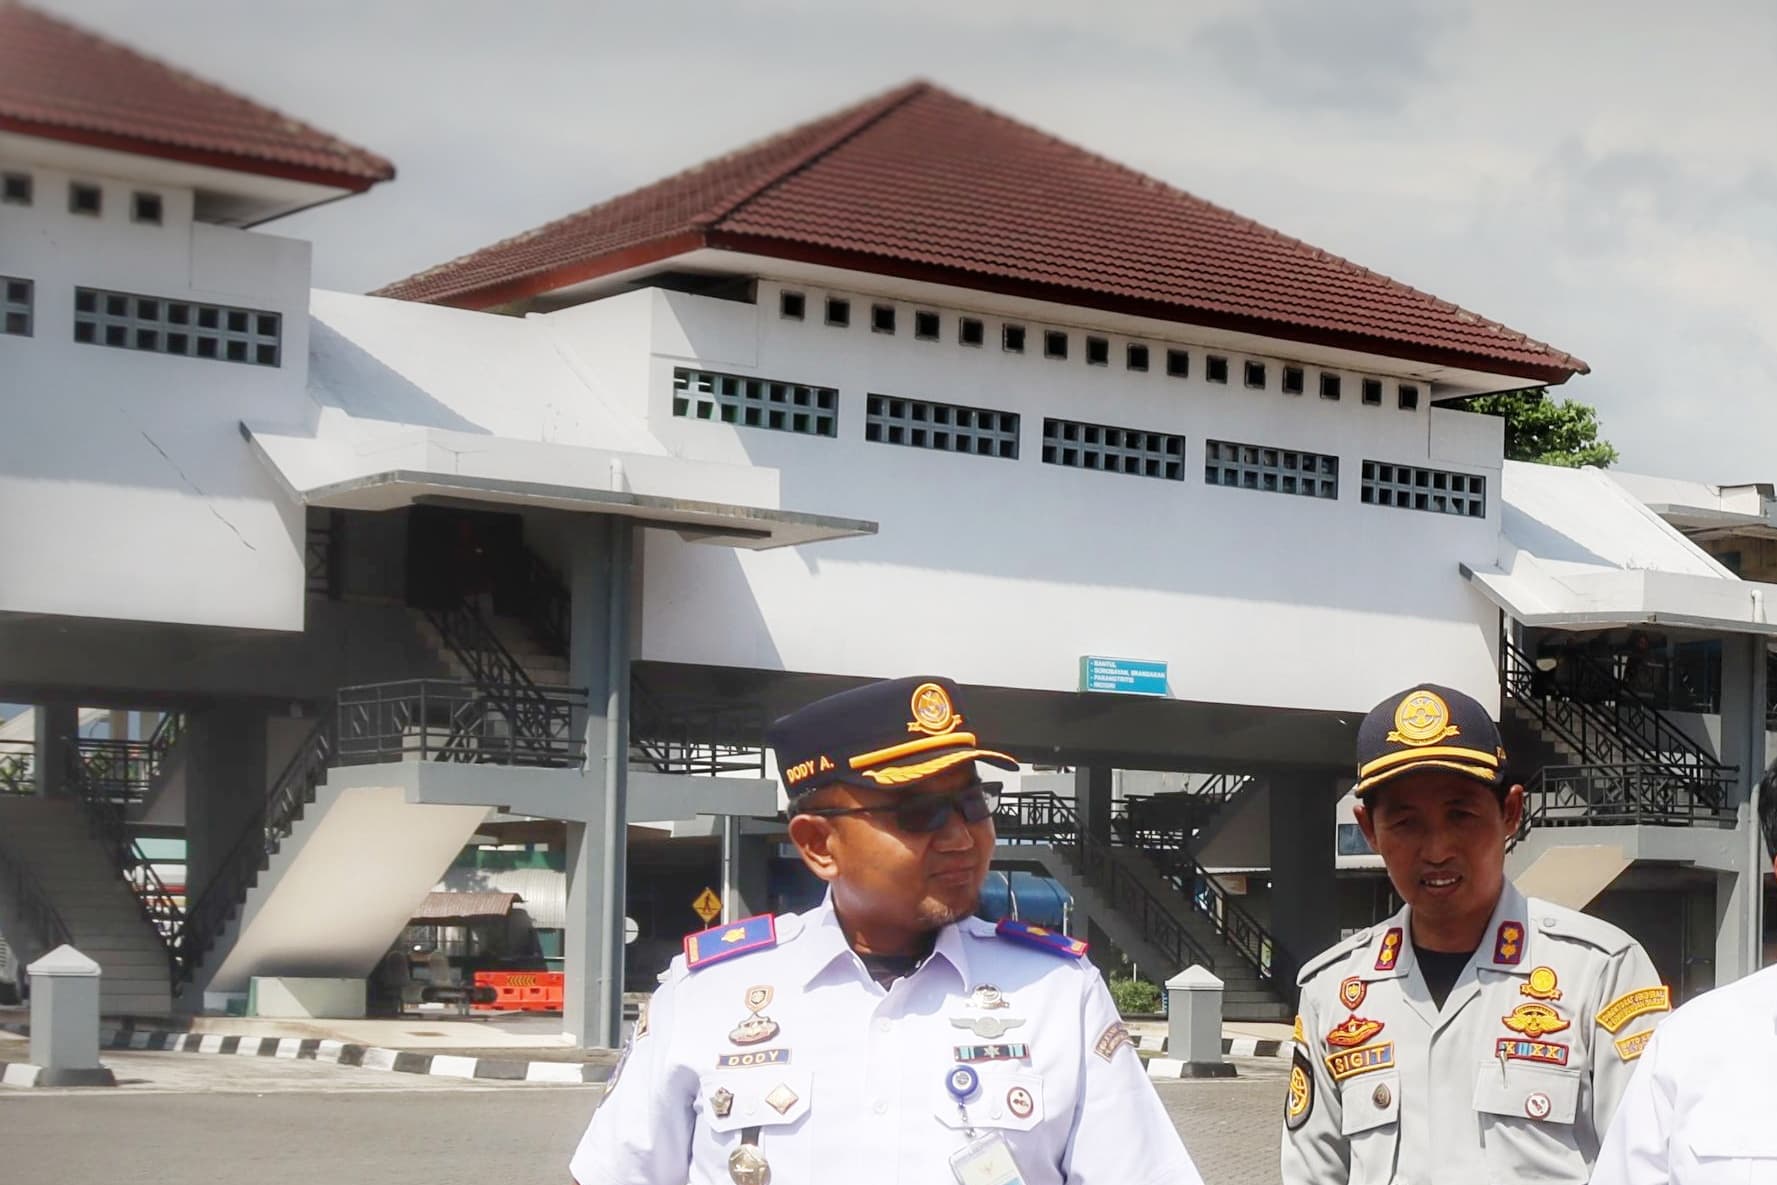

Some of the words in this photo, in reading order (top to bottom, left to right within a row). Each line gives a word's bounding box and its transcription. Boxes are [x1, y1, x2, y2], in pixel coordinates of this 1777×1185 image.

[786, 760, 815, 783] DODY
[820, 755, 835, 771] A.
[728, 1050, 779, 1065] DODY
[1335, 1047, 1385, 1073] SIGIT
